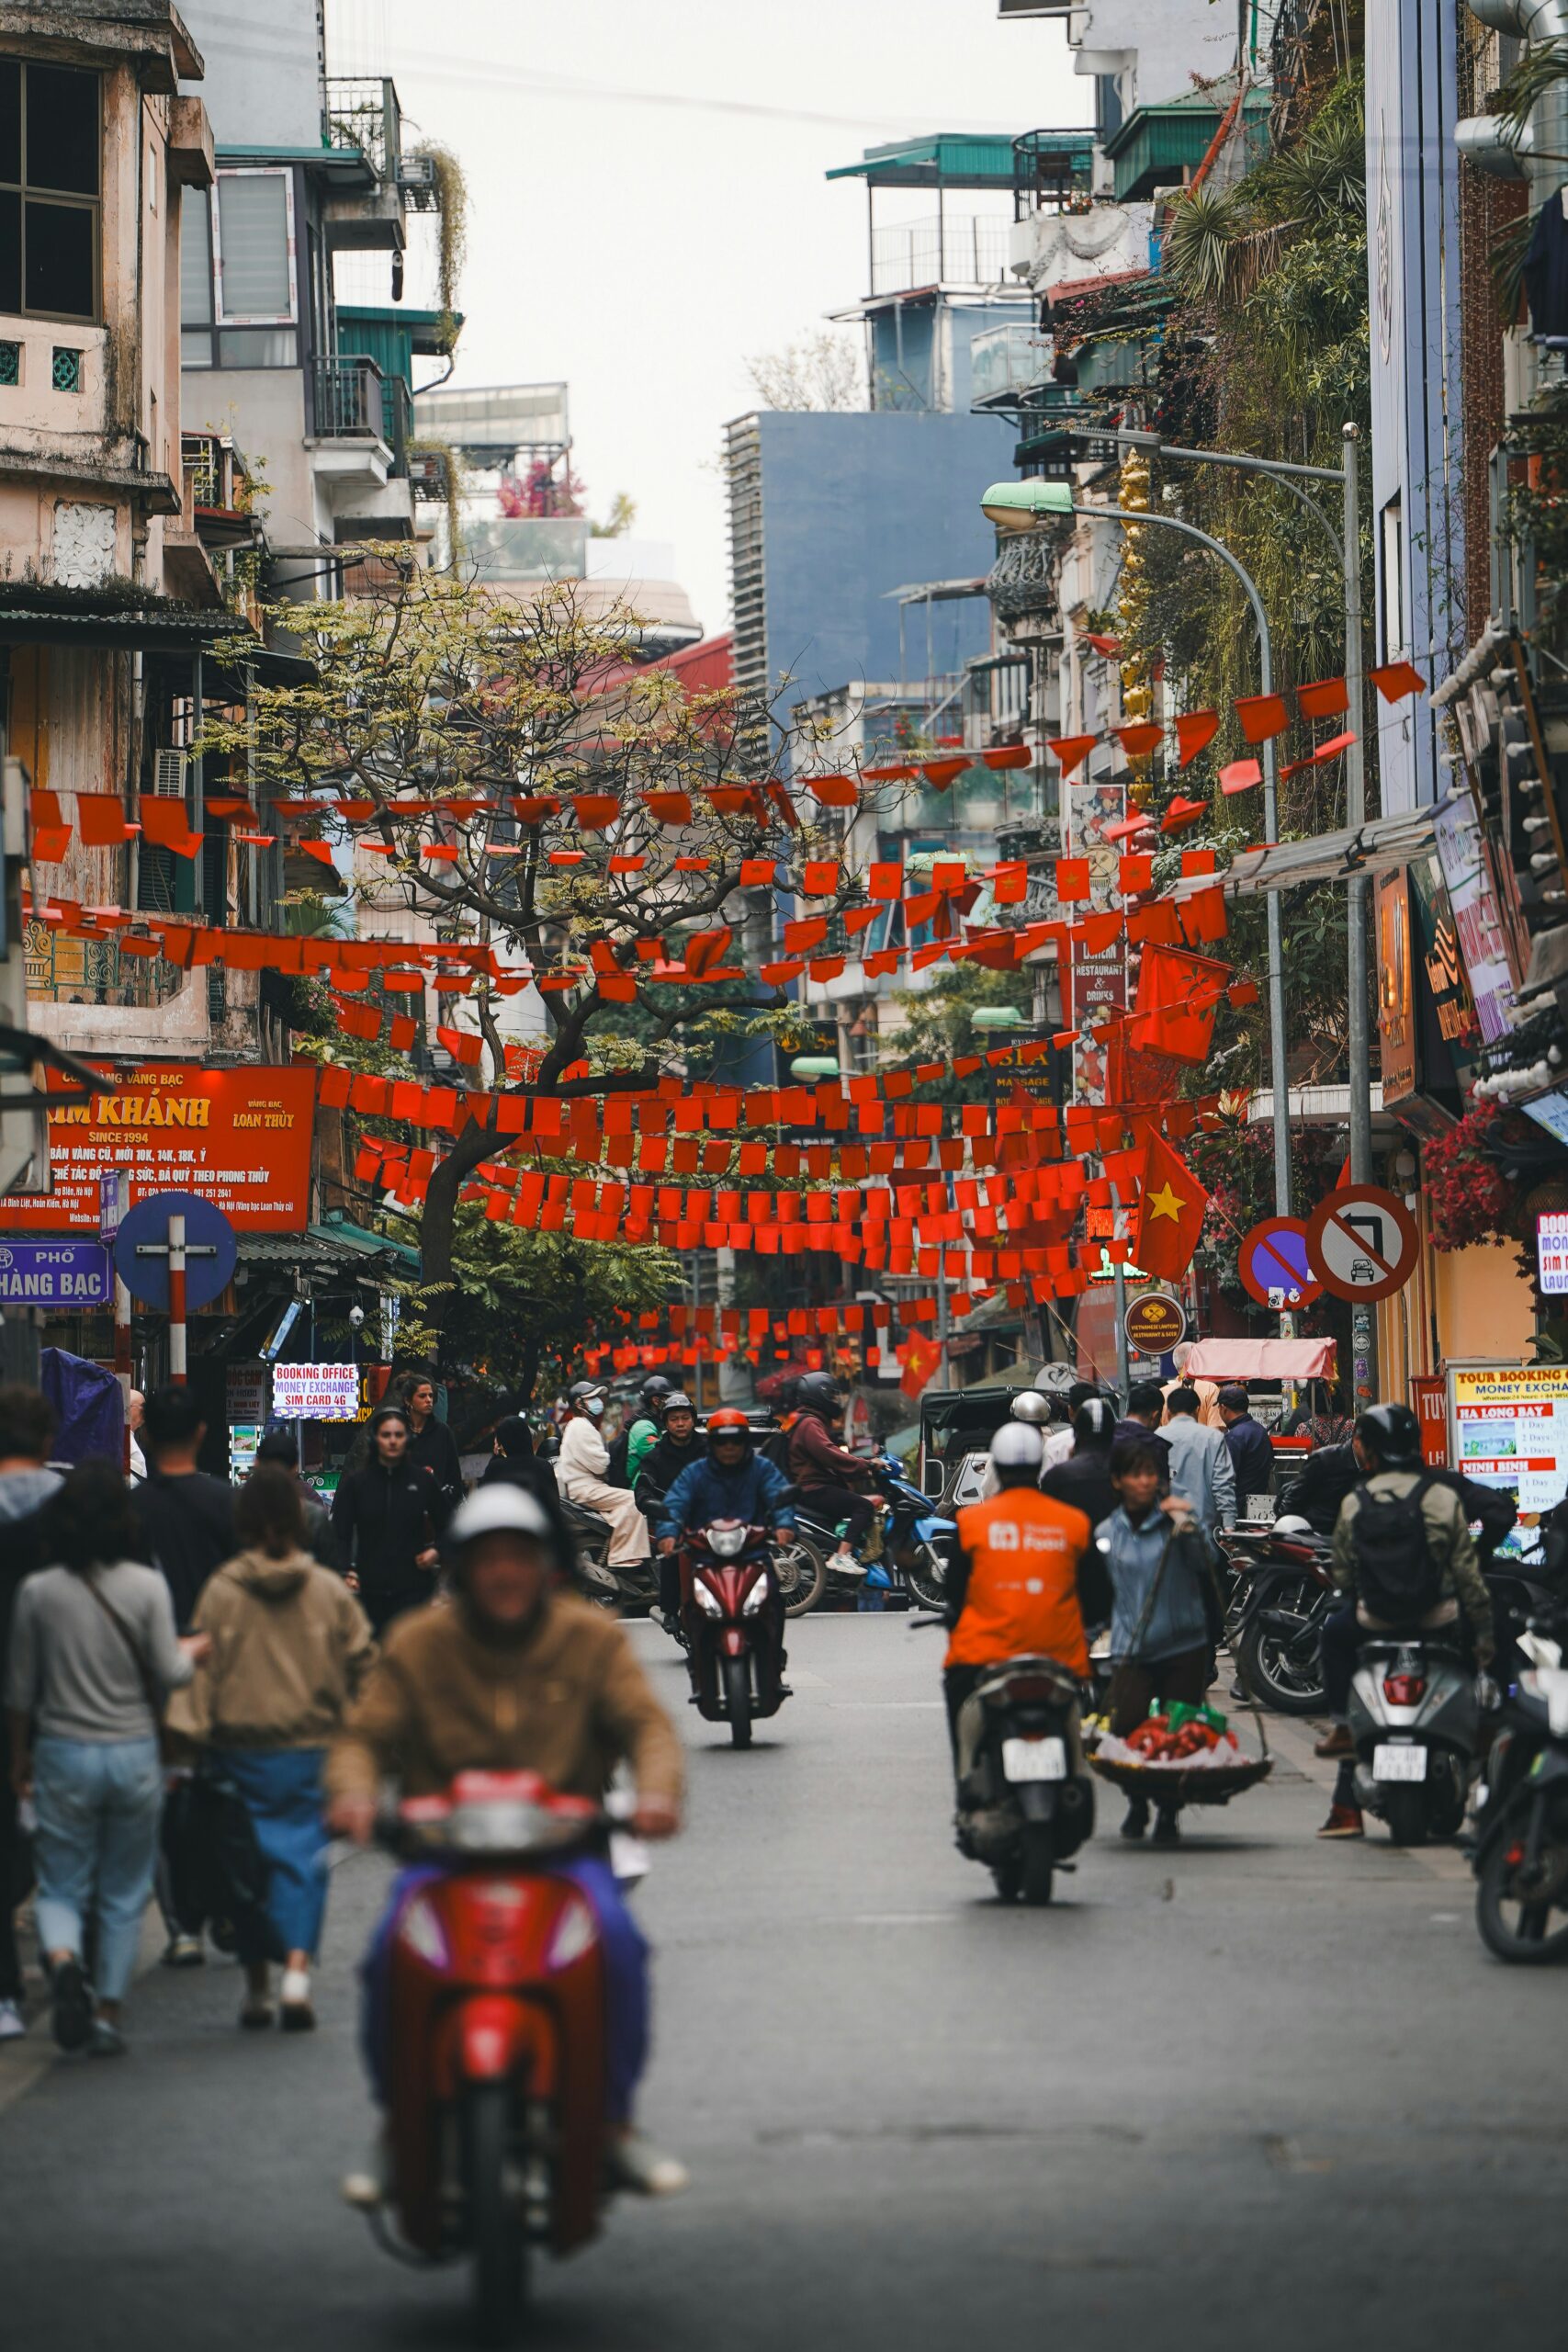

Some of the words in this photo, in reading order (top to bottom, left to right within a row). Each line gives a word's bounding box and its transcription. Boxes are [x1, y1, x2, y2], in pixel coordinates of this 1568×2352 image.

[1077, 965, 1122, 976] RESTAURANT
[1094, 978, 1106, 989] &
[1086, 991, 1114, 1001] DRINKS
[127, 1070, 156, 1084] VÀNG
[160, 1074, 184, 1088] BẠC
[997, 1078, 1050, 1087] MASAGE
[47, 1099, 91, 1125] IM
[96, 1088, 211, 1126] KHÁNH
[232, 1114, 262, 1128] LOAN
[264, 1110, 294, 1128] THỦY
[88, 1131, 121, 1143] SINCE
[123, 1133, 148, 1144] 1994
[50, 1145, 69, 1160] BÁN
[72, 1146, 96, 1160] VÀNG
[115, 1146, 133, 1161] MỚI
[136, 1149, 154, 1163] 10K,
[157, 1150, 175, 1163] 14K,
[178, 1150, 196, 1163] 18K,
[71, 1165, 87, 1181] TÁC
[158, 1167, 171, 1182] ĐÁ
[193, 1170, 215, 1182] THEO
[217, 1170, 245, 1183] PHONG
[247, 1167, 270, 1183] THỦY
[206, 1189, 216, 1197] 251
[69, 1213, 91, 1223] Website:
[1540, 1216, 1568, 1234] BOO
[35, 1247, 75, 1263] PHỐ
[1543, 1256, 1561, 1271] SIM
[60, 1273, 101, 1300] BẠC
[276, 1367, 319, 1380] BOOKING
[322, 1367, 355, 1379] OFFICE
[1458, 1372, 1495, 1384] TOUR
[1499, 1369, 1562, 1382] BOOKING
[276, 1381, 307, 1393] MONEY
[310, 1381, 355, 1394] EXCHANGE
[1475, 1385, 1521, 1395] MONEY
[285, 1395, 304, 1406] SIM
[306, 1395, 332, 1406] CARD
[333, 1395, 346, 1406] 4G
[1459, 1408, 1479, 1419] HA
[1481, 1407, 1516, 1419] LONG
[1517, 1405, 1544, 1418] BAY
[1428, 1450, 1444, 1465] LH
[1462, 1462, 1495, 1474] NINH
[1497, 1460, 1529, 1473] BINH
